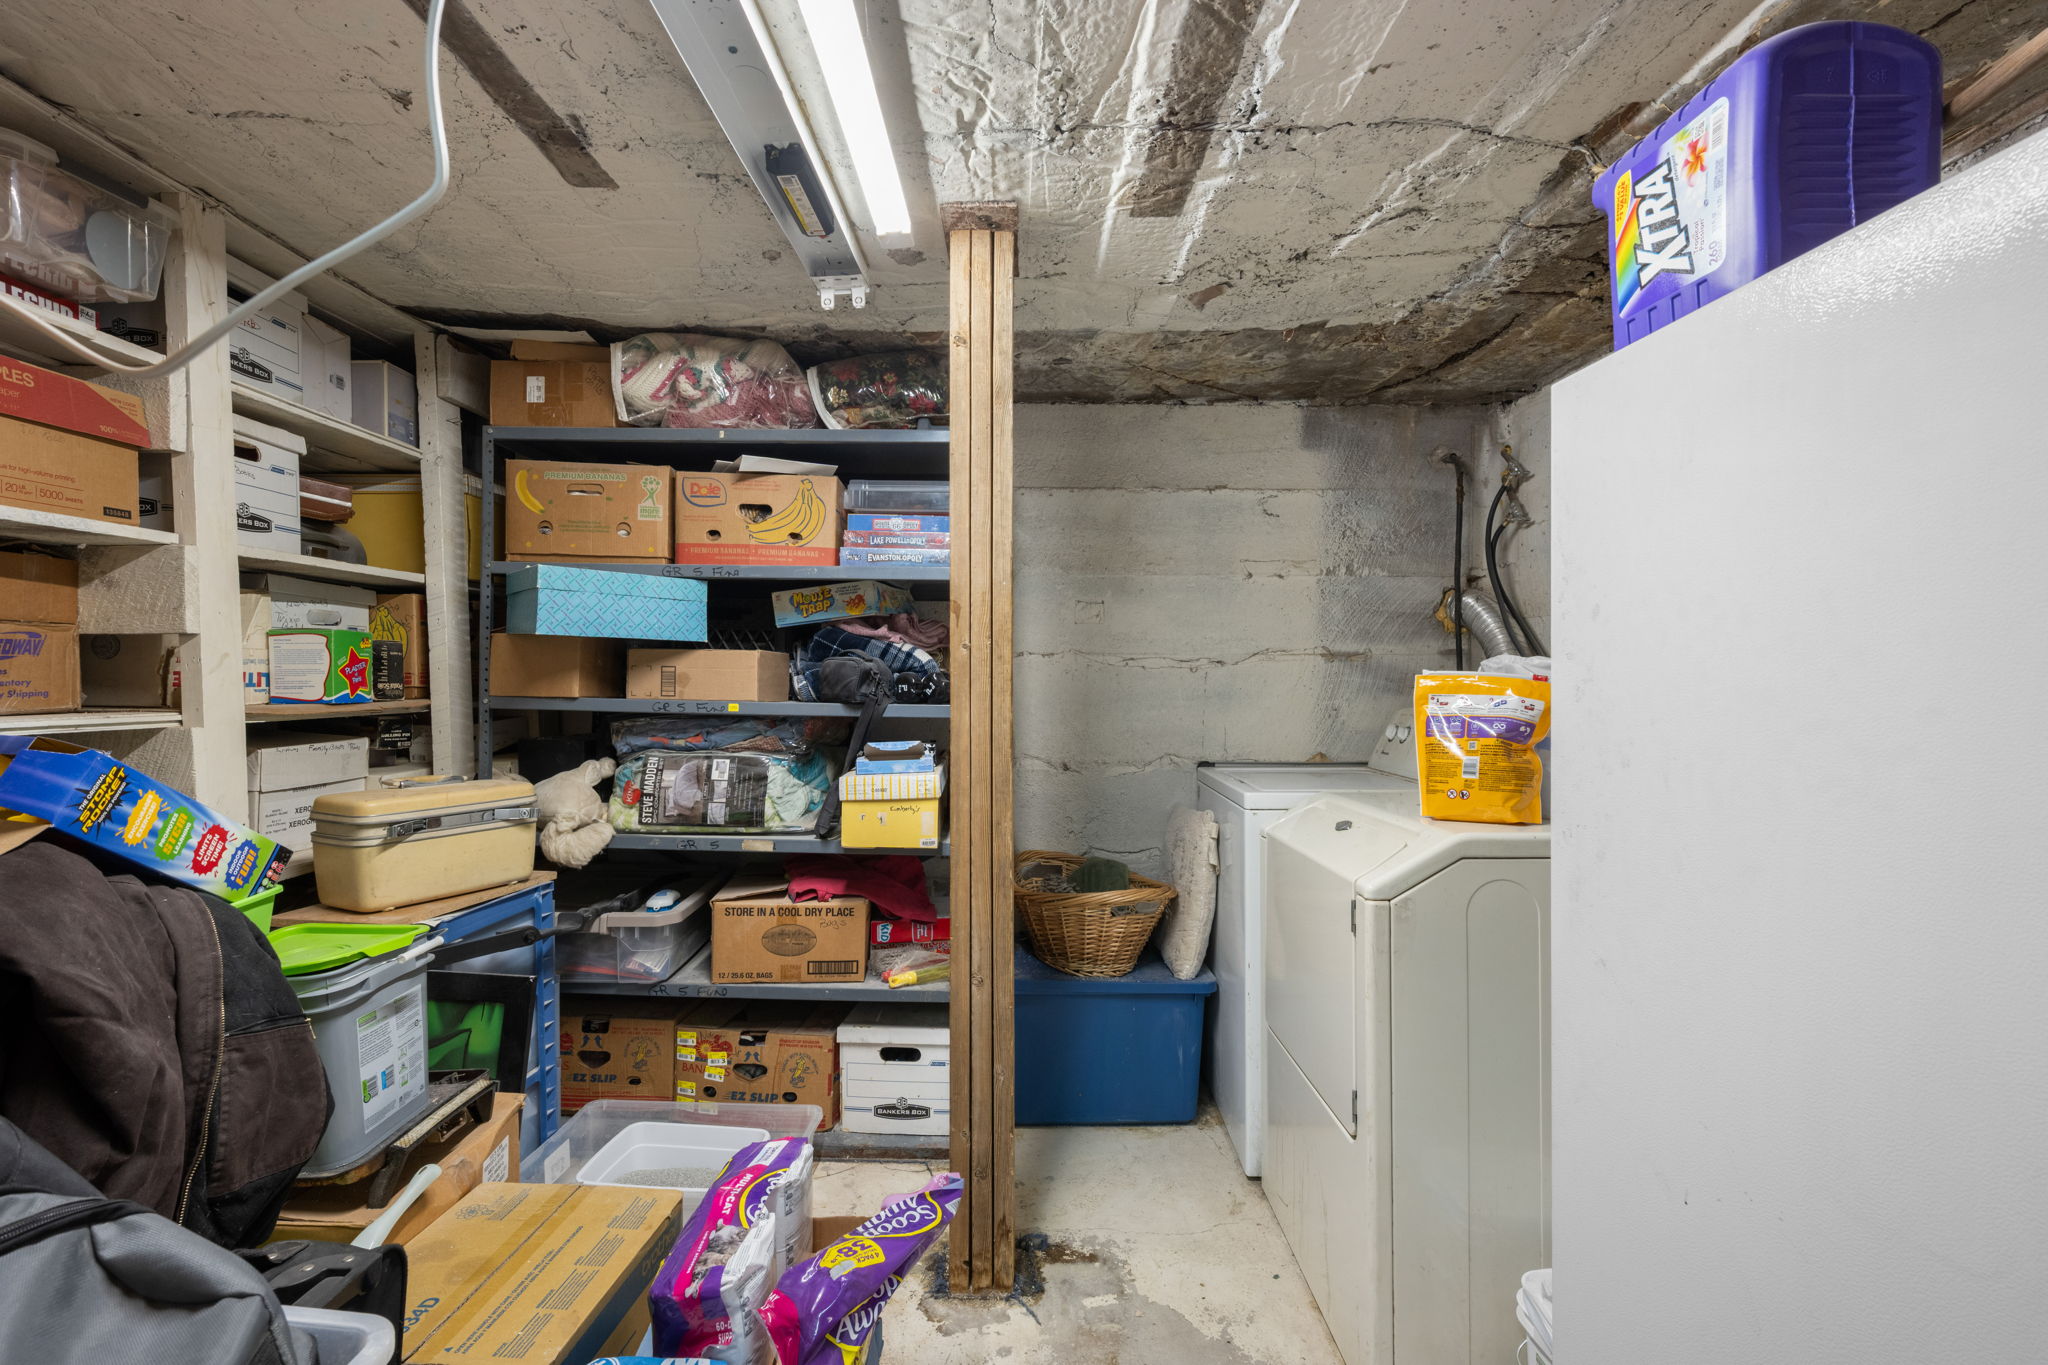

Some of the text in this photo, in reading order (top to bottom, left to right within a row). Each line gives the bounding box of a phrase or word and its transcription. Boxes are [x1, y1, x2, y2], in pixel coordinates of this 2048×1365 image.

[1634, 157, 1694, 289] XTRA
[255, 367, 270, 379] BOX
[543, 471, 628, 482] PREMIUM BANANAS
[5, 482, 18, 493] 20
[40, 488, 64, 501] 5000
[689, 482, 721, 496] Dole
[254, 520, 269, 529] BOX
[869, 536, 884, 545] LAKE
[792, 587, 833, 608] MOUSE
[652, 701, 670, 713] GR
[78, 773, 107, 811] THE ORIGINAL
[79, 766, 118, 823] STOMP
[82, 766, 126, 833] ROCKET
[641, 756, 659, 824] STEVE MADDEN
[158, 812, 180, 848] PROMOTES
[172, 822, 192, 855] LEARNING
[196, 833, 213, 861] LIMITS
[201, 833, 221, 867] SCREEN
[209, 840, 225, 863] TIME!
[228, 849, 242, 874] INDOOR
[233, 846, 249, 876] OUTDOOR
[235, 849, 257, 886] FUN!
[724, 906, 855, 918] STORE IN A COOL DRY PLACE
[880, 923, 890, 942] KID
[572, 1073, 617, 1083] EZ SLIP
[682, 1063, 731, 1077] BANS
[730, 1091, 779, 1103] EZ SLIP
[877, 1108, 910, 1116] BANKERS
[721, 1173, 754, 1215] MULTI-CAT
[863, 1204, 937, 1238] Scoop
[837, 1239, 873, 1258] 38
[856, 1255, 875, 1263] PACK
[715, 1320, 732, 1332] 60-D
